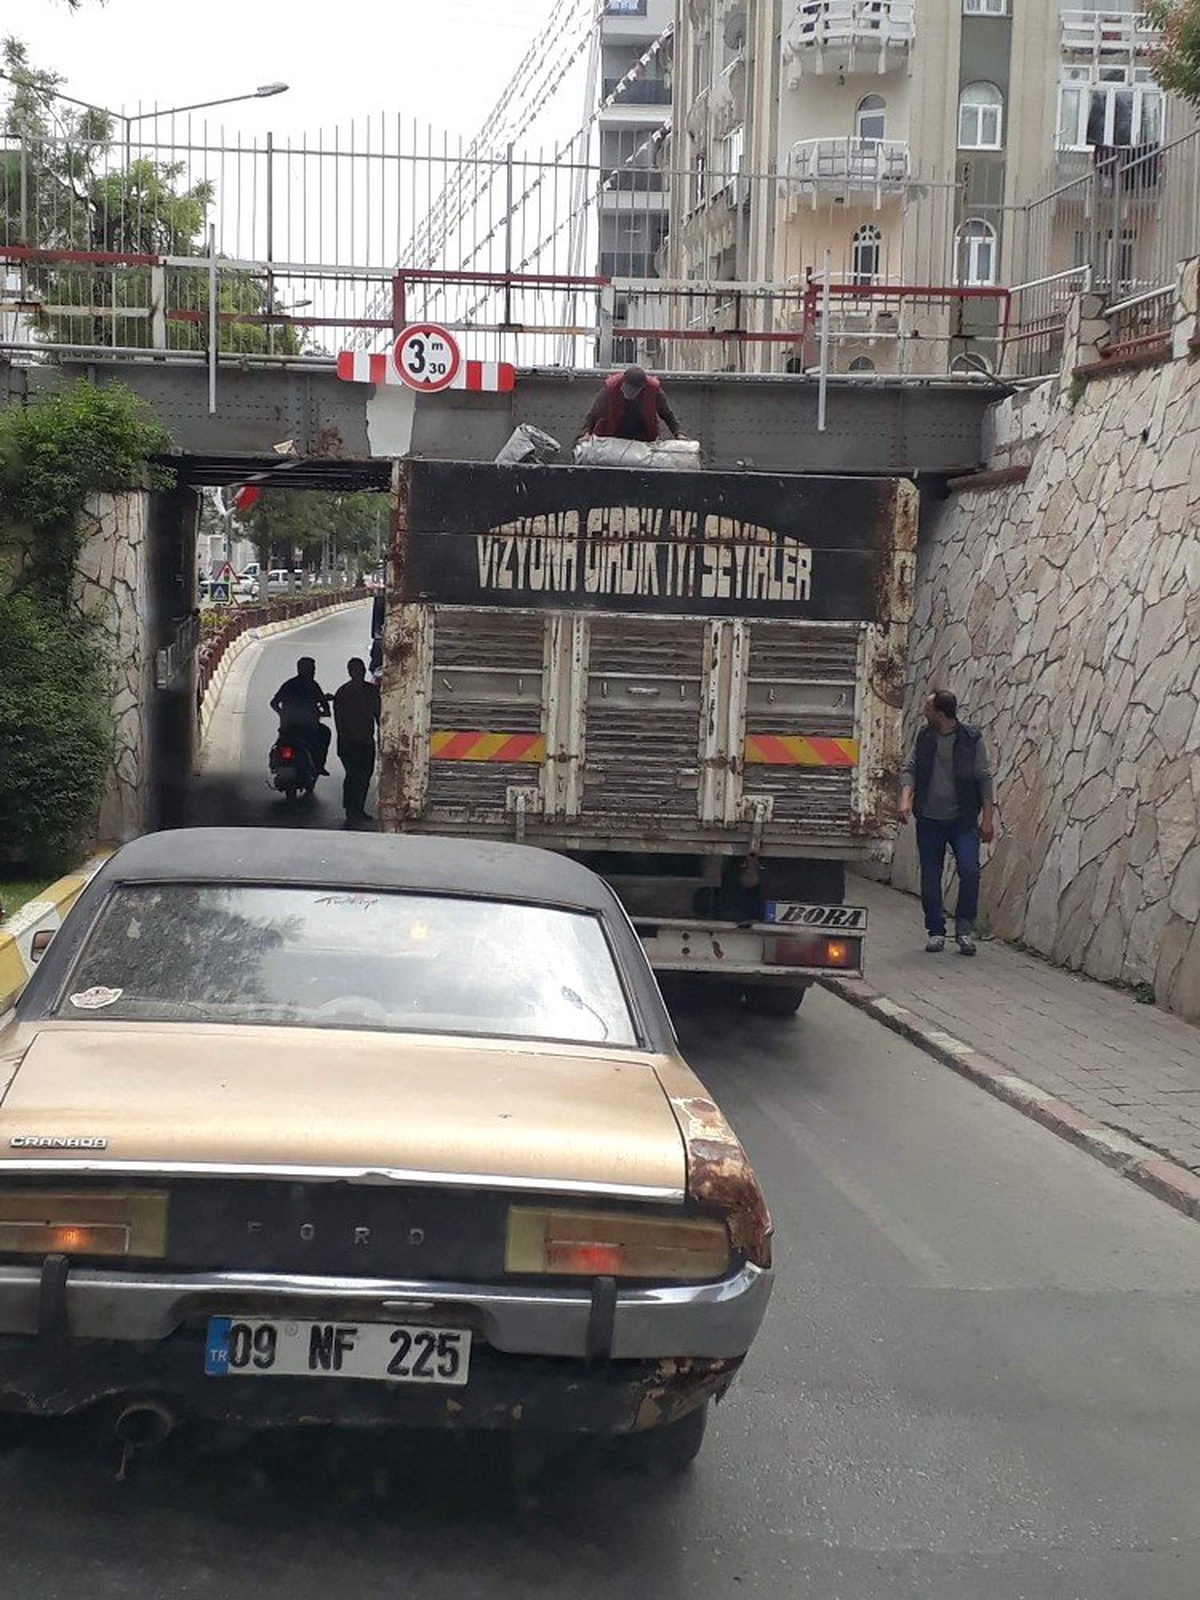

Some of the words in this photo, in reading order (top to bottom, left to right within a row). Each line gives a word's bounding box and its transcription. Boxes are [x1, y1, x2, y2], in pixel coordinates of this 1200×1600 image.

[408, 338, 426, 374] 3
[431, 342, 444, 350] m
[429, 362, 446, 374] 30
[779, 906, 861, 926] BORA
[10, 1136, 107, 1149] GRANADA
[248, 1220, 425, 1245] FORD
[209, 1349, 228, 1361] TR
[228, 1323, 277, 1369] 09
[308, 1324, 358, 1371] NF
[387, 1329, 461, 1377] 225
